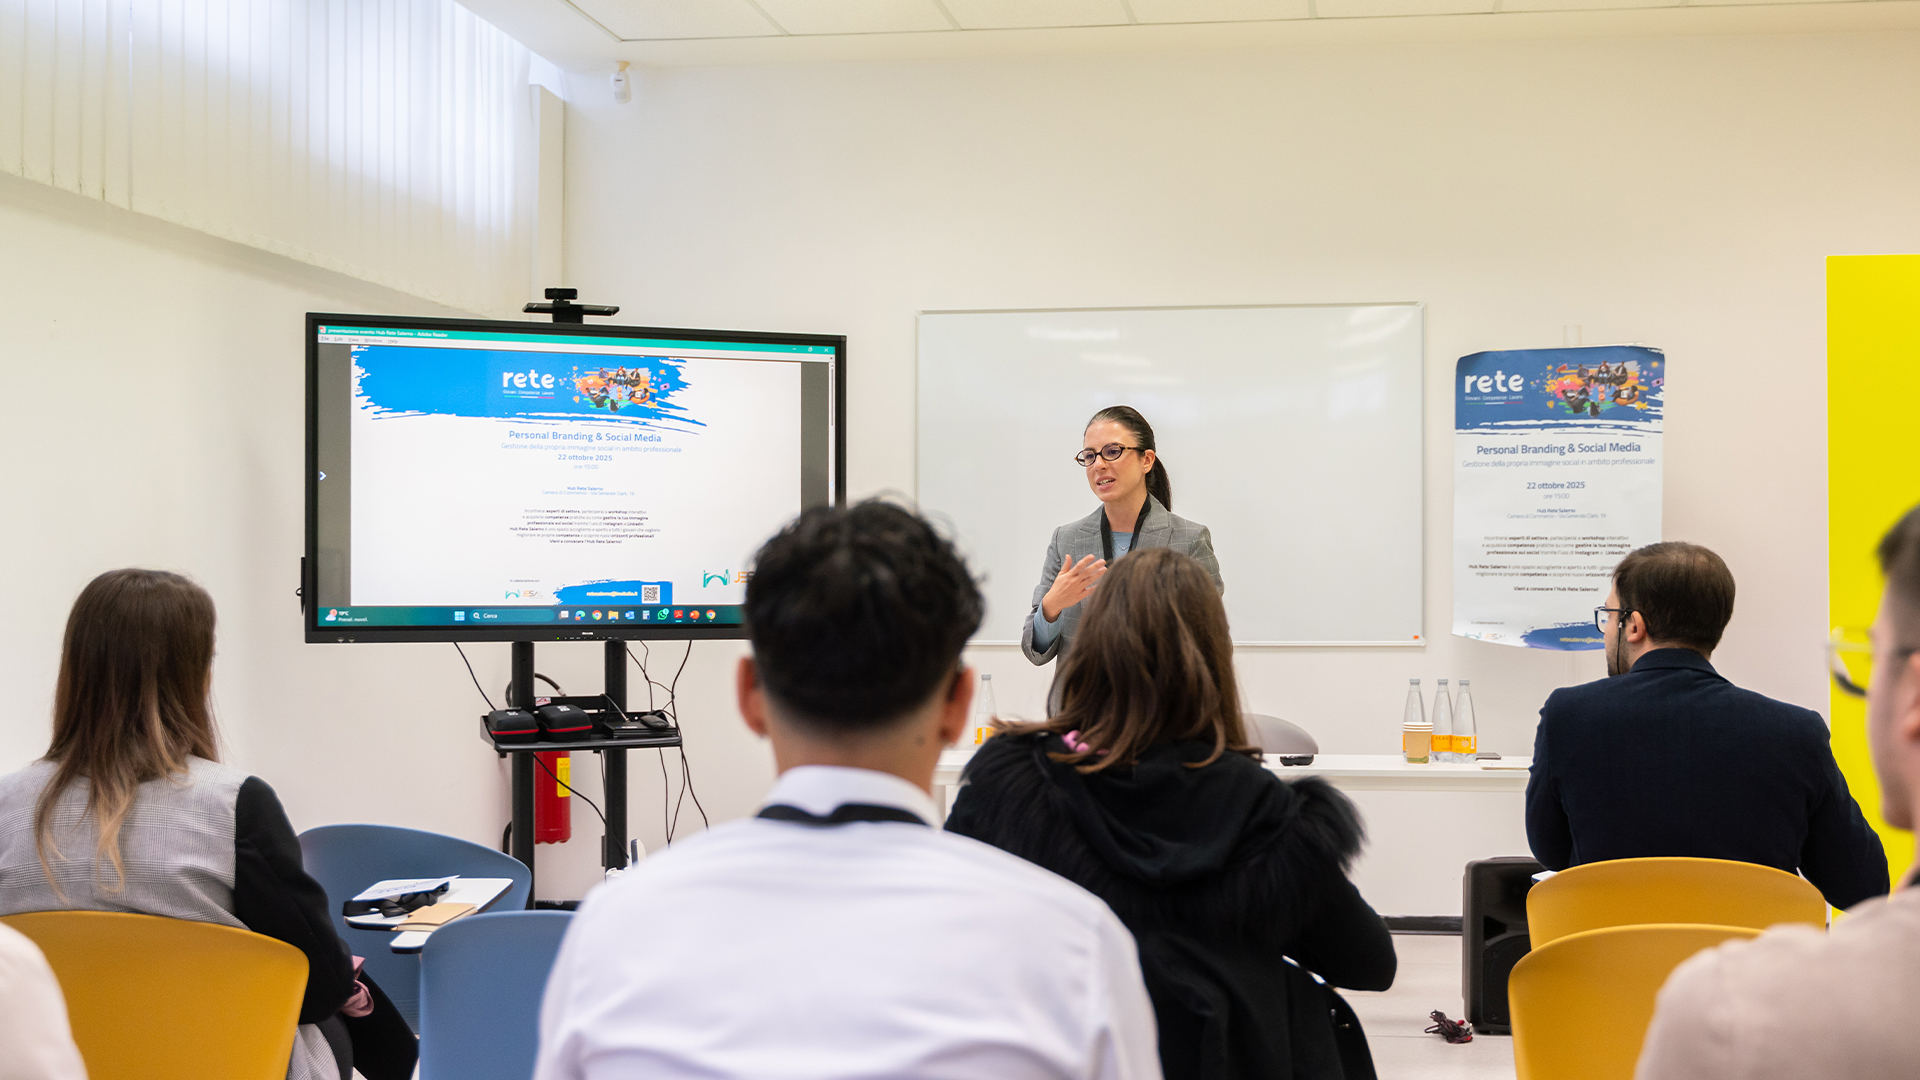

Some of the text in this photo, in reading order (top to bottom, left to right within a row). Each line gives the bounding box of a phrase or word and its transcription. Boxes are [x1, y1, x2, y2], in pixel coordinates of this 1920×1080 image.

[503, 369, 555, 389] rete
[1464, 370, 1524, 393] rete
[509, 430, 662, 443] Personal Branding & Social Media
[1477, 442, 1641, 456] Personal Branding & Social Media
[1529, 460, 1560, 468] immagine
[1611, 458, 1655, 466] professionale
